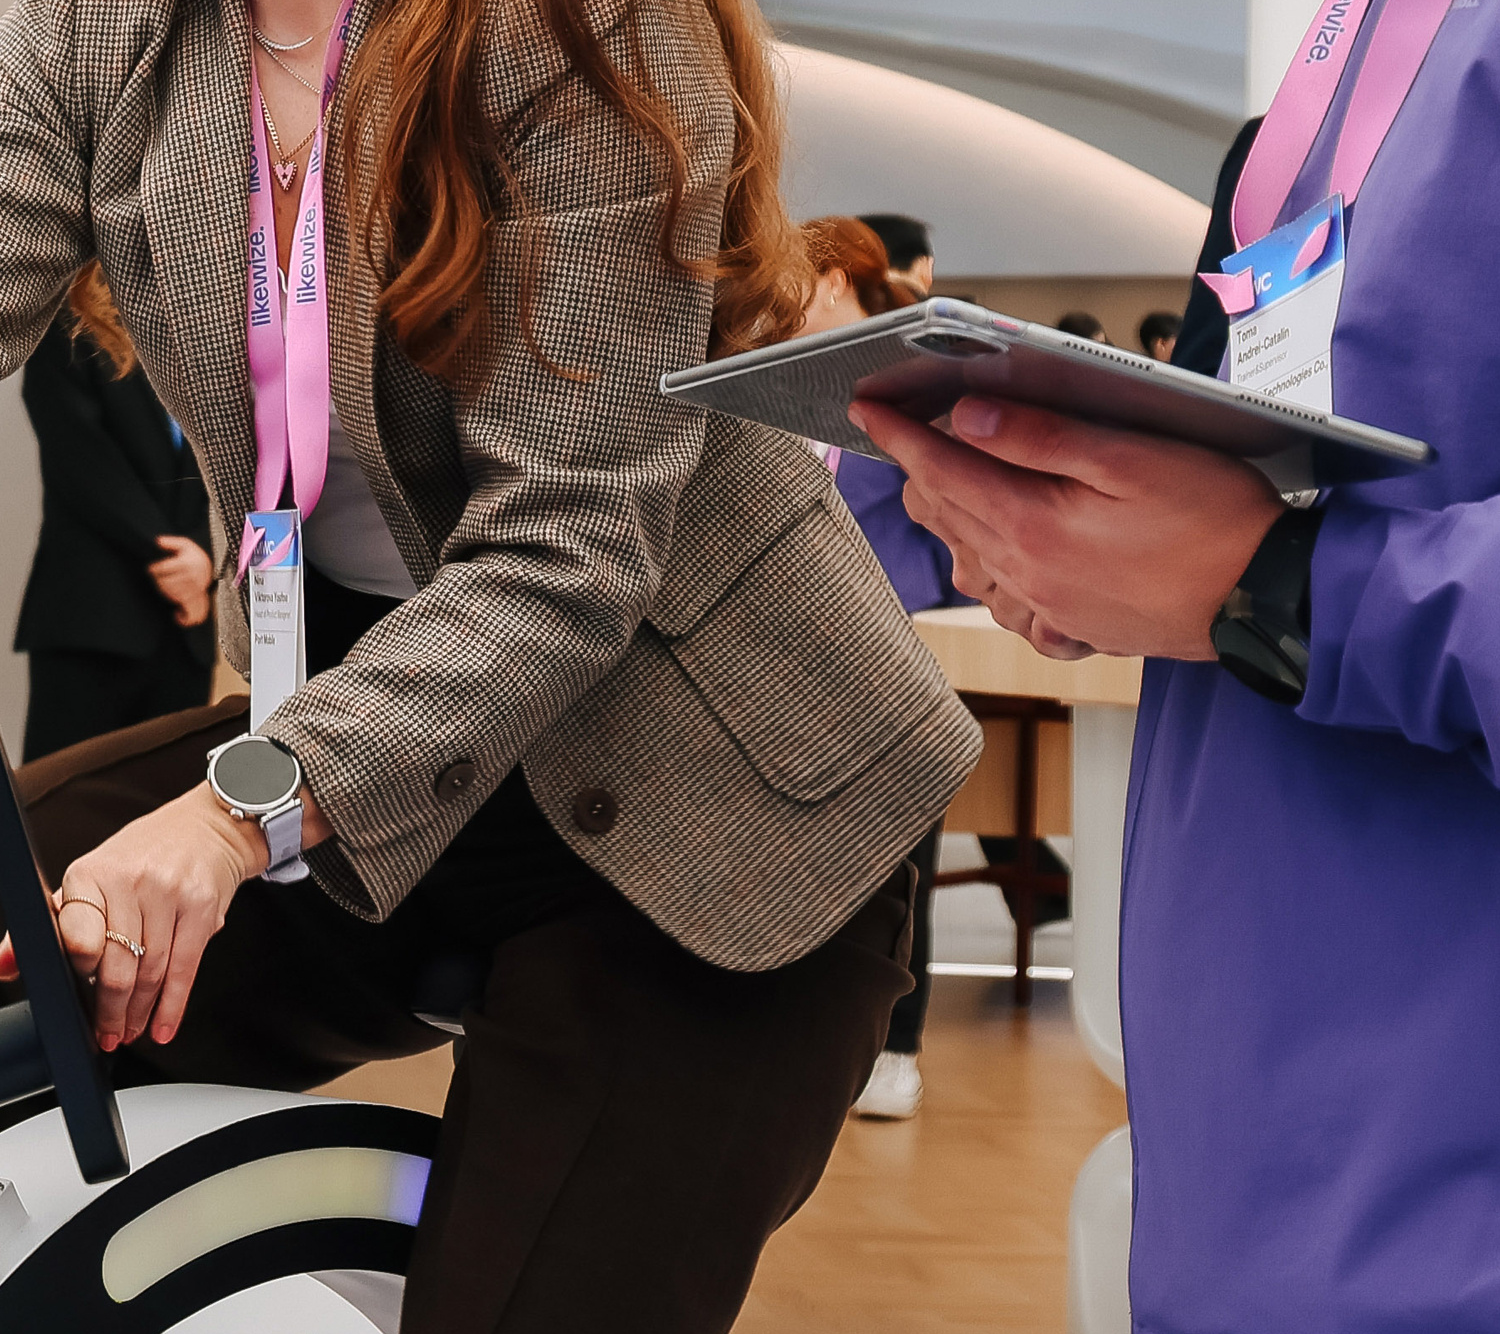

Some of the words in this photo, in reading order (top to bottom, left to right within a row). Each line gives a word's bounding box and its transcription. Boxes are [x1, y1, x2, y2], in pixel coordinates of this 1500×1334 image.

[251, 225, 271, 327] likewize.
[297, 202, 317, 304] likewize.
[1236, 325, 1258, 346] Toma
